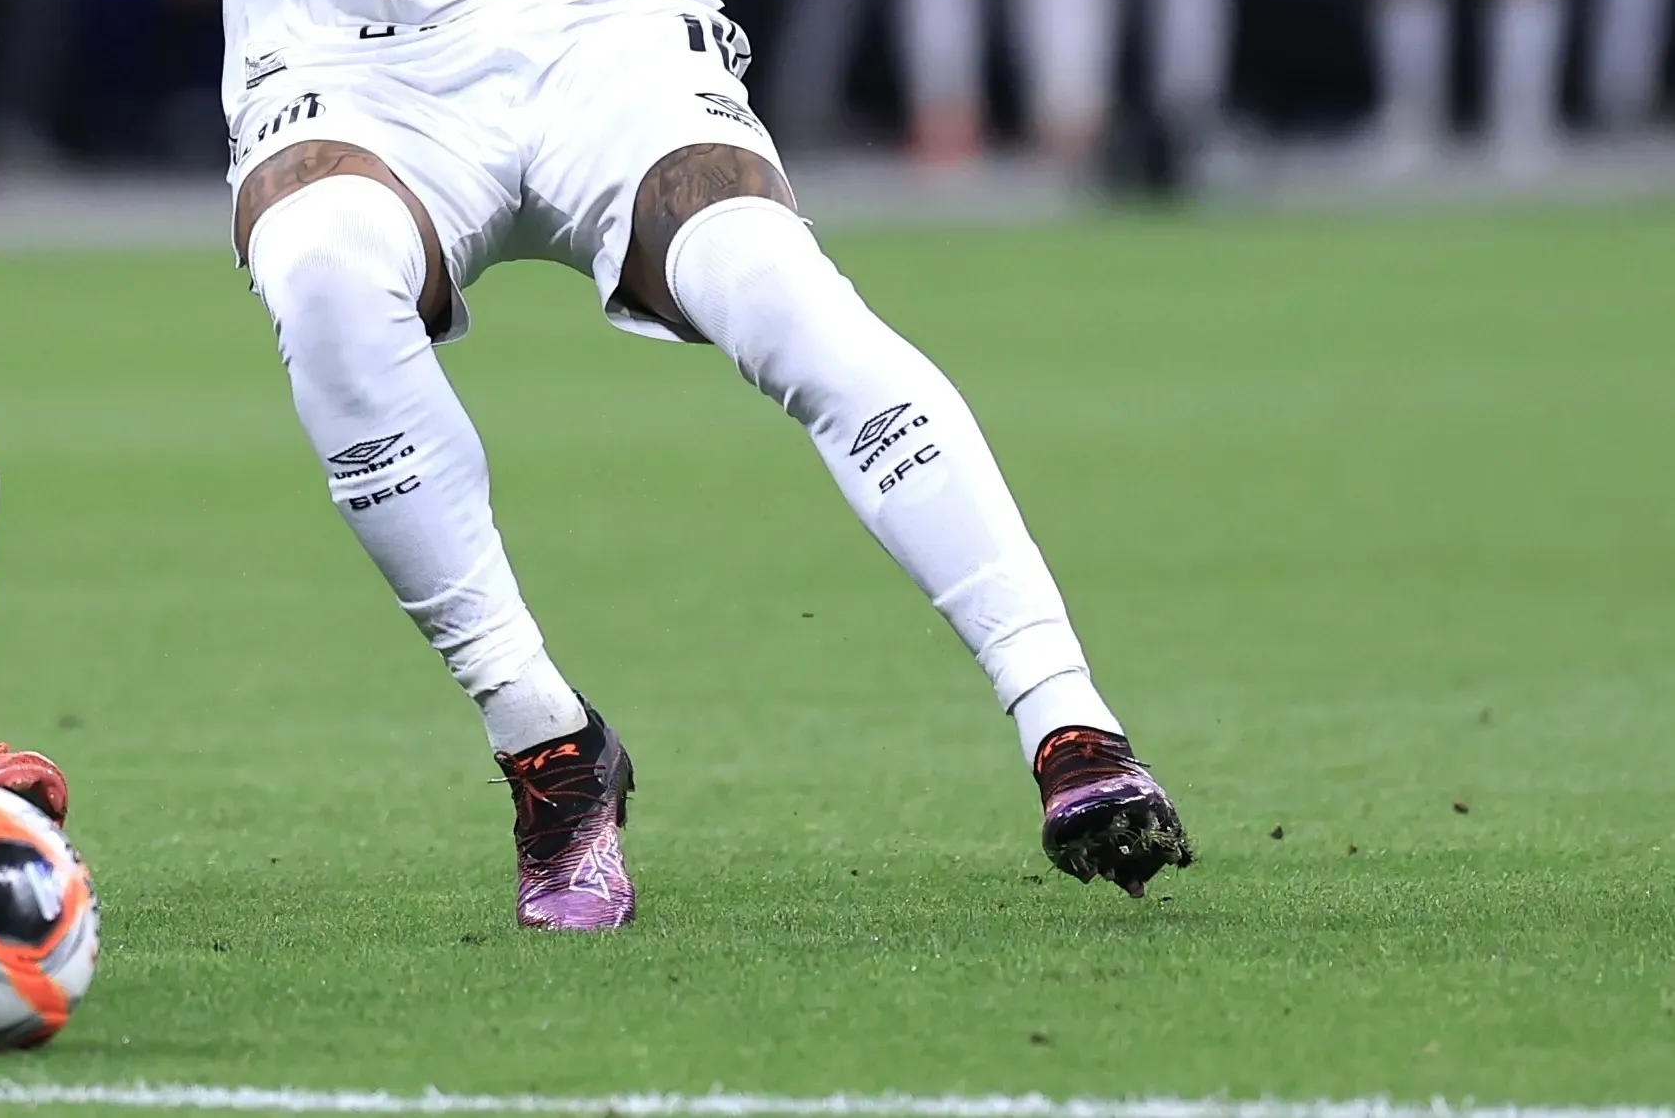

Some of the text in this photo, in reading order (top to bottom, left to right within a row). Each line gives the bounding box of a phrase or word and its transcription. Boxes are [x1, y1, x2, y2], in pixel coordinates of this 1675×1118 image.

[333, 444, 416, 480] umbro
[858, 414, 929, 473] umbro
[878, 443, 941, 495] SFC
[349, 474, 421, 511] SFC
